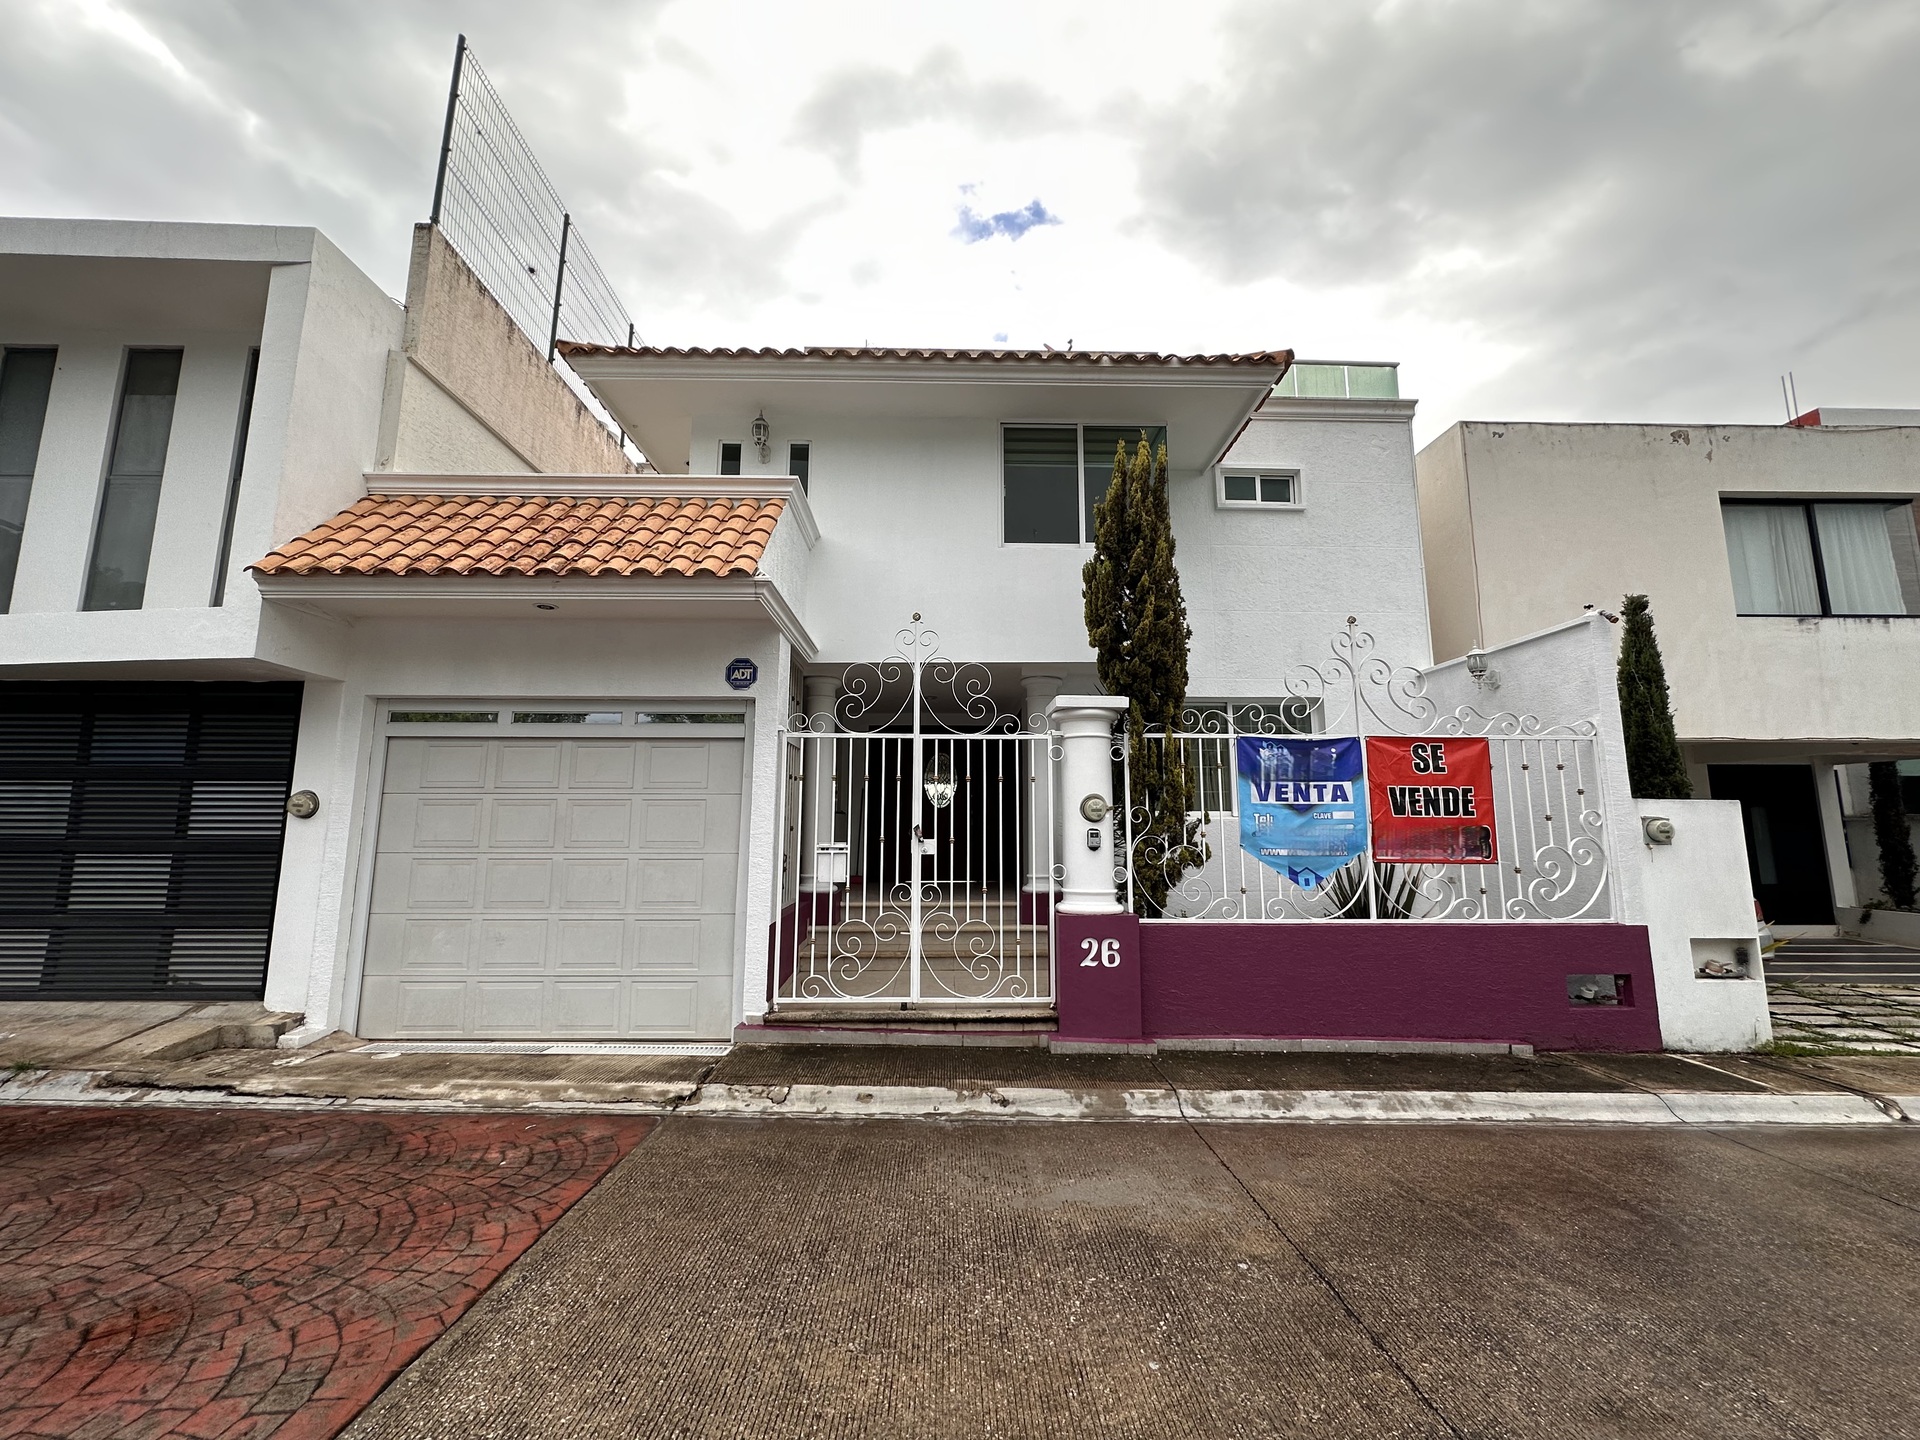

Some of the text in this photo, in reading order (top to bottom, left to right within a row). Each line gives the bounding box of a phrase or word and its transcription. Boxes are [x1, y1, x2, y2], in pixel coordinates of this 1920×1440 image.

[731, 669, 752, 680] ADT
[1411, 743, 1447, 774] SE
[1253, 783, 1349, 802] VENTA
[1387, 786, 1476, 817] VENDE
[1080, 938, 1121, 967] 26
